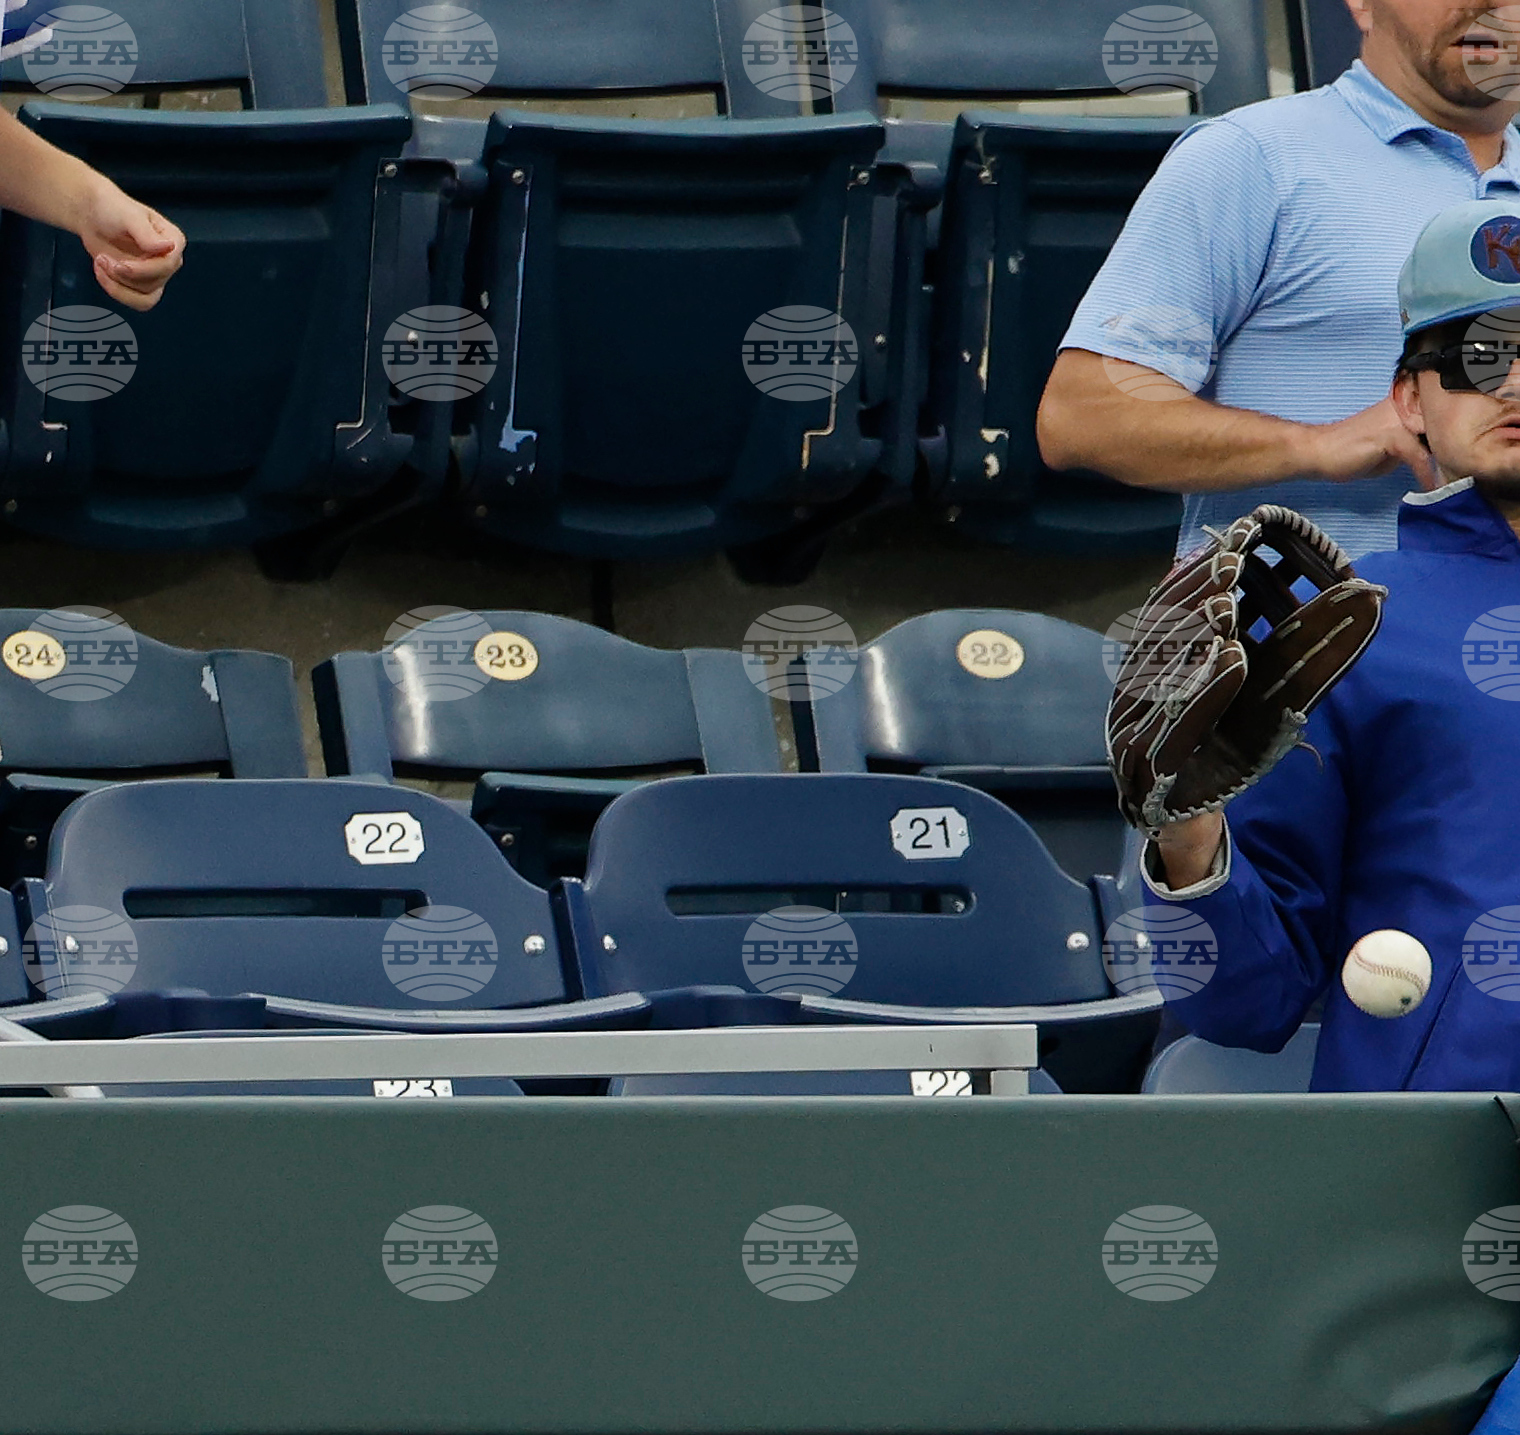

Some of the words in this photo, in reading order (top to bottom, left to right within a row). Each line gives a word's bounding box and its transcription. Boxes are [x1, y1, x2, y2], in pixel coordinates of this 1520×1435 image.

[14, 642, 56, 668] 24
[486, 643, 527, 669] 23
[970, 641, 1012, 667] 22
[362, 821, 410, 854] 22
[909, 815, 951, 850] 21
